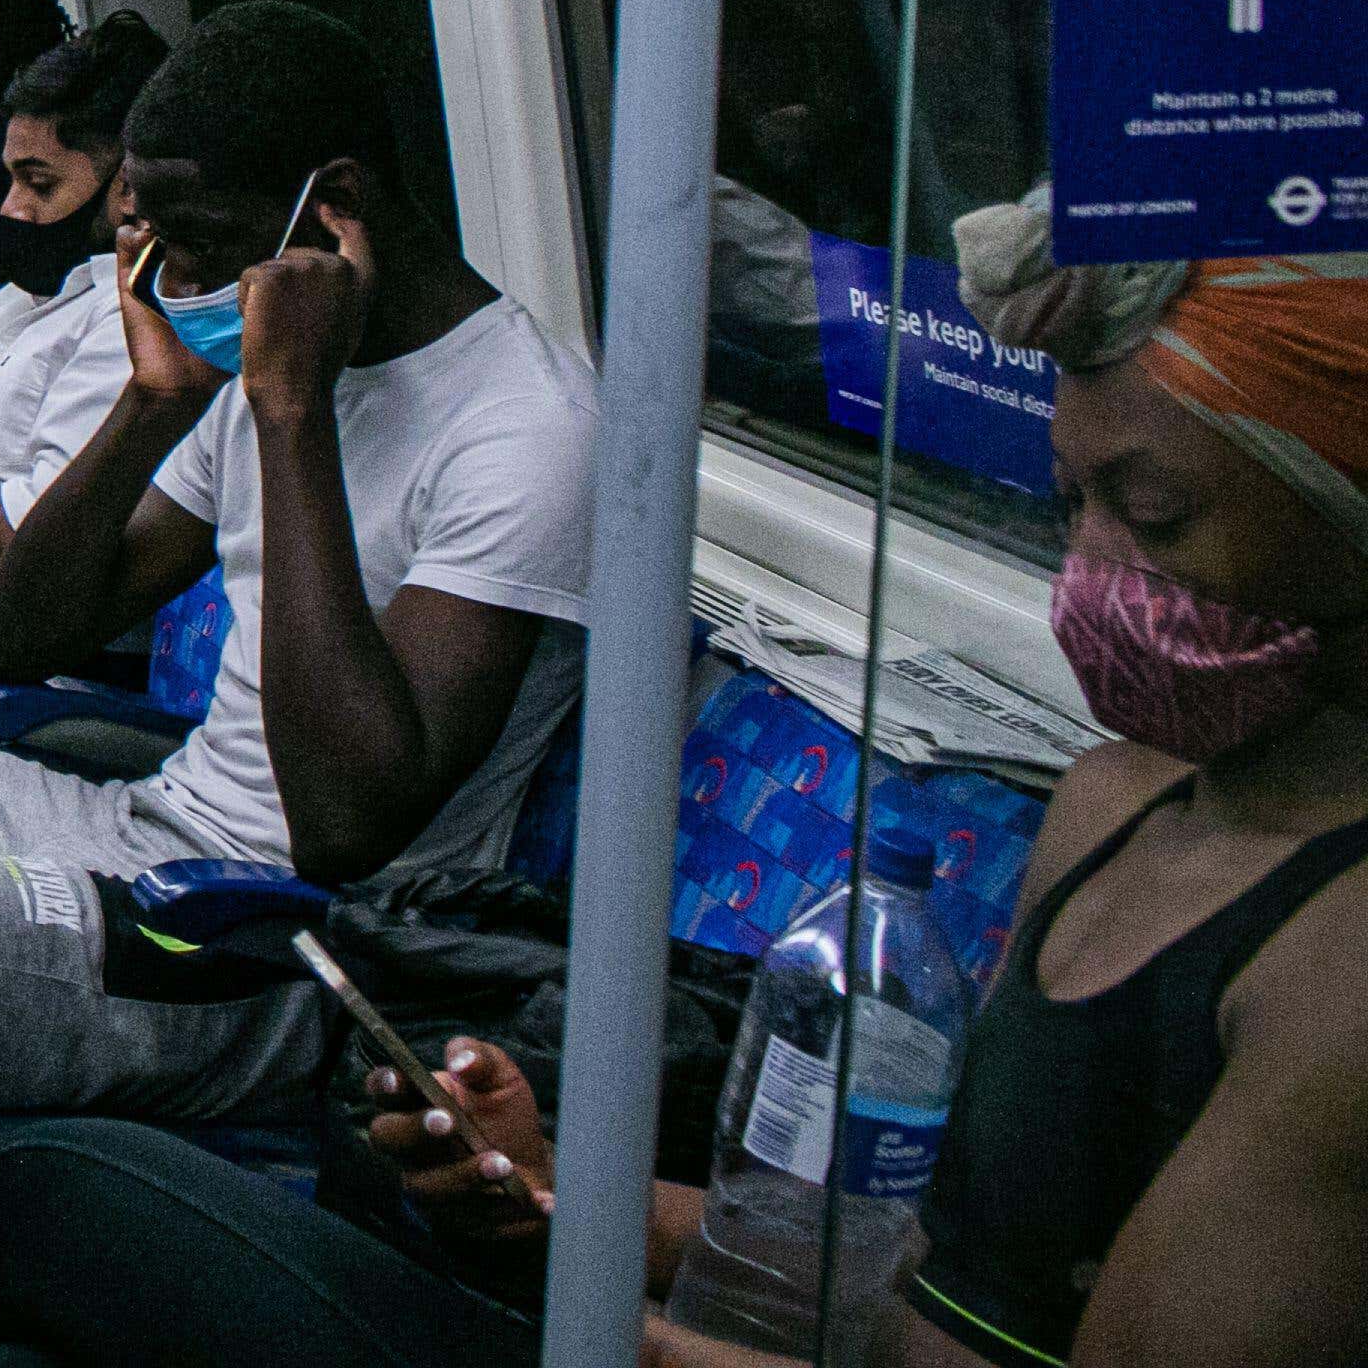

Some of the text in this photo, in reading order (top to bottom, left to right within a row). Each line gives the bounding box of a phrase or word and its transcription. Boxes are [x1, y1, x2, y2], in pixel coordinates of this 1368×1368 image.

[1153, 92, 1239, 111] Maintain
[1258, 87, 1272, 107] 2
[1275, 88, 1338, 105] metre
[1124, 110, 1363, 135] distance where possible
[849, 287, 1048, 375] Please keep your
[924, 361, 980, 395] Maintain
[981, 384, 1021, 409] social
